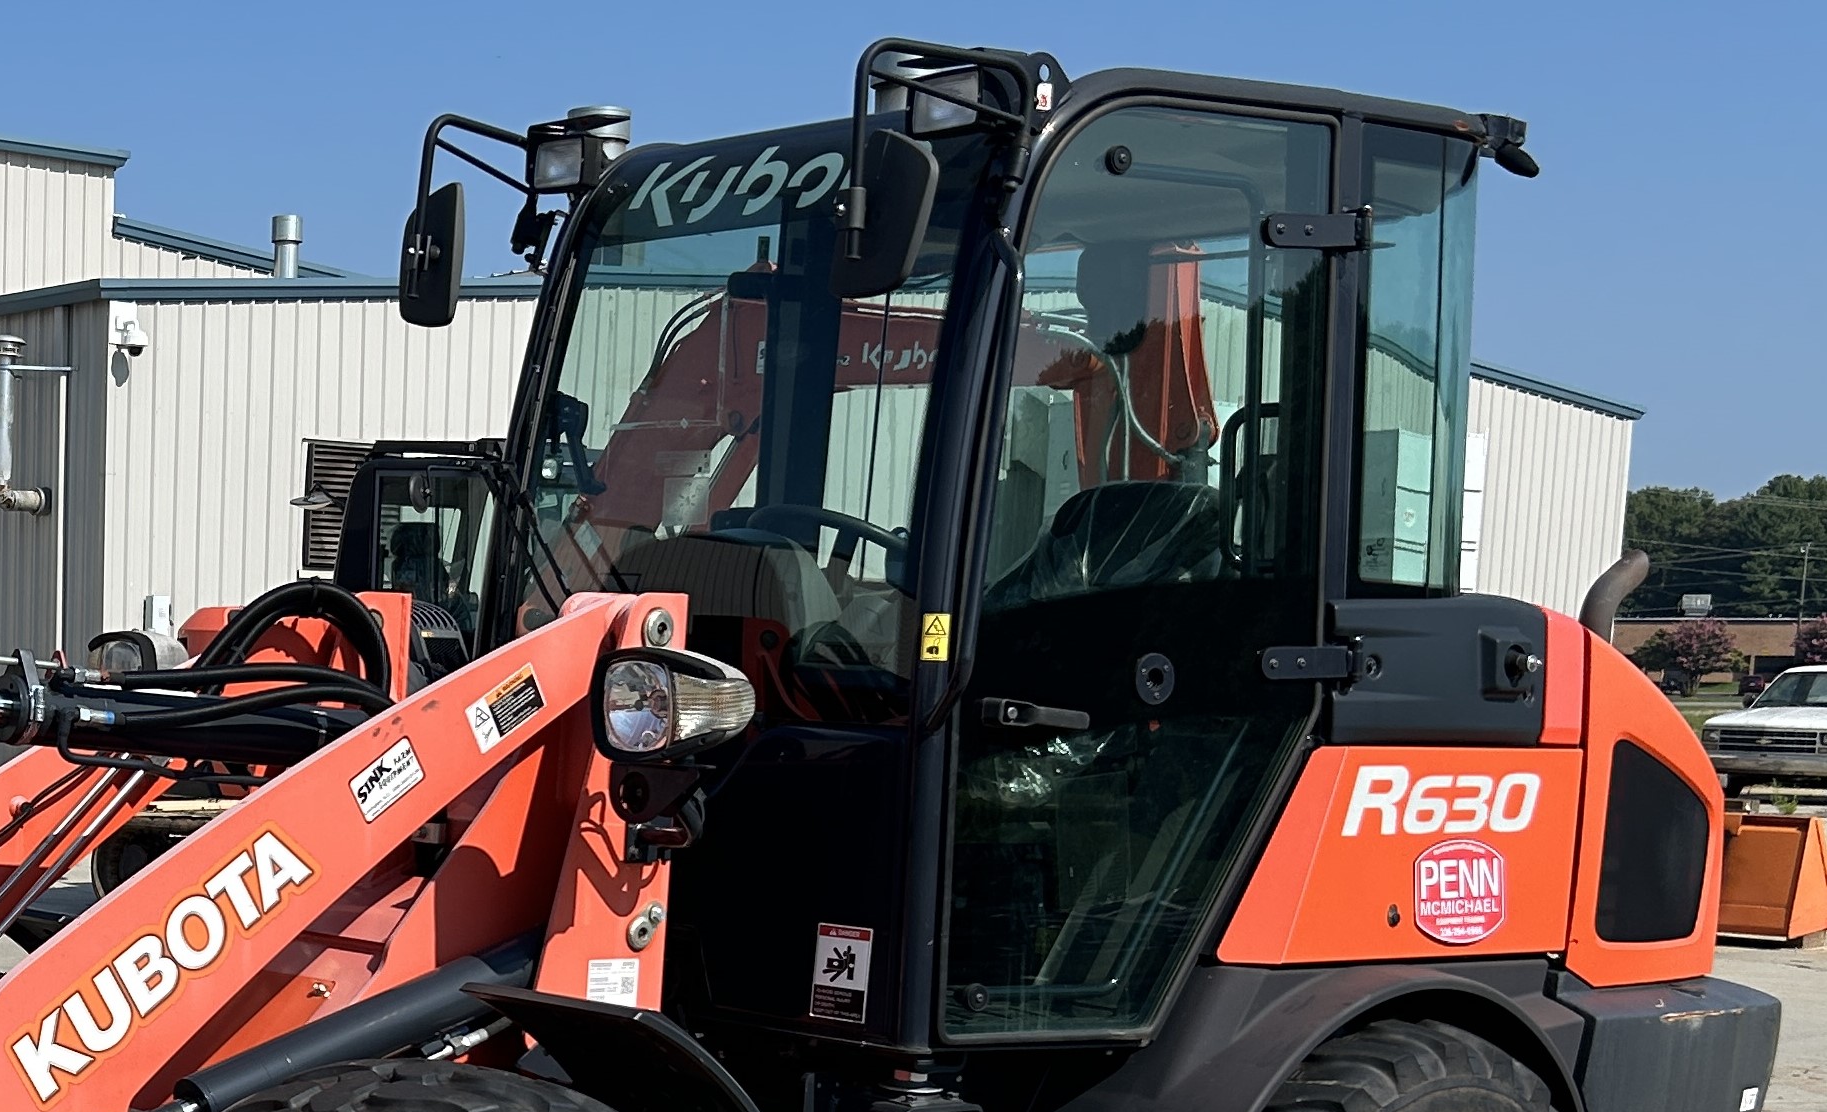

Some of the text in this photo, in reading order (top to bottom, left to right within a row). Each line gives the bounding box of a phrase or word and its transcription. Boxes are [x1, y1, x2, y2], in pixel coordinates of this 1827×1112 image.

[628, 145, 851, 228] Kubo
[357, 757, 392, 804] SINK
[1341, 764, 1541, 837] R630
[1420, 857, 1499, 900] PENN
[1420, 898, 1499, 916] MCMICHAEL
[10, 829, 315, 1103] KUBOTA
